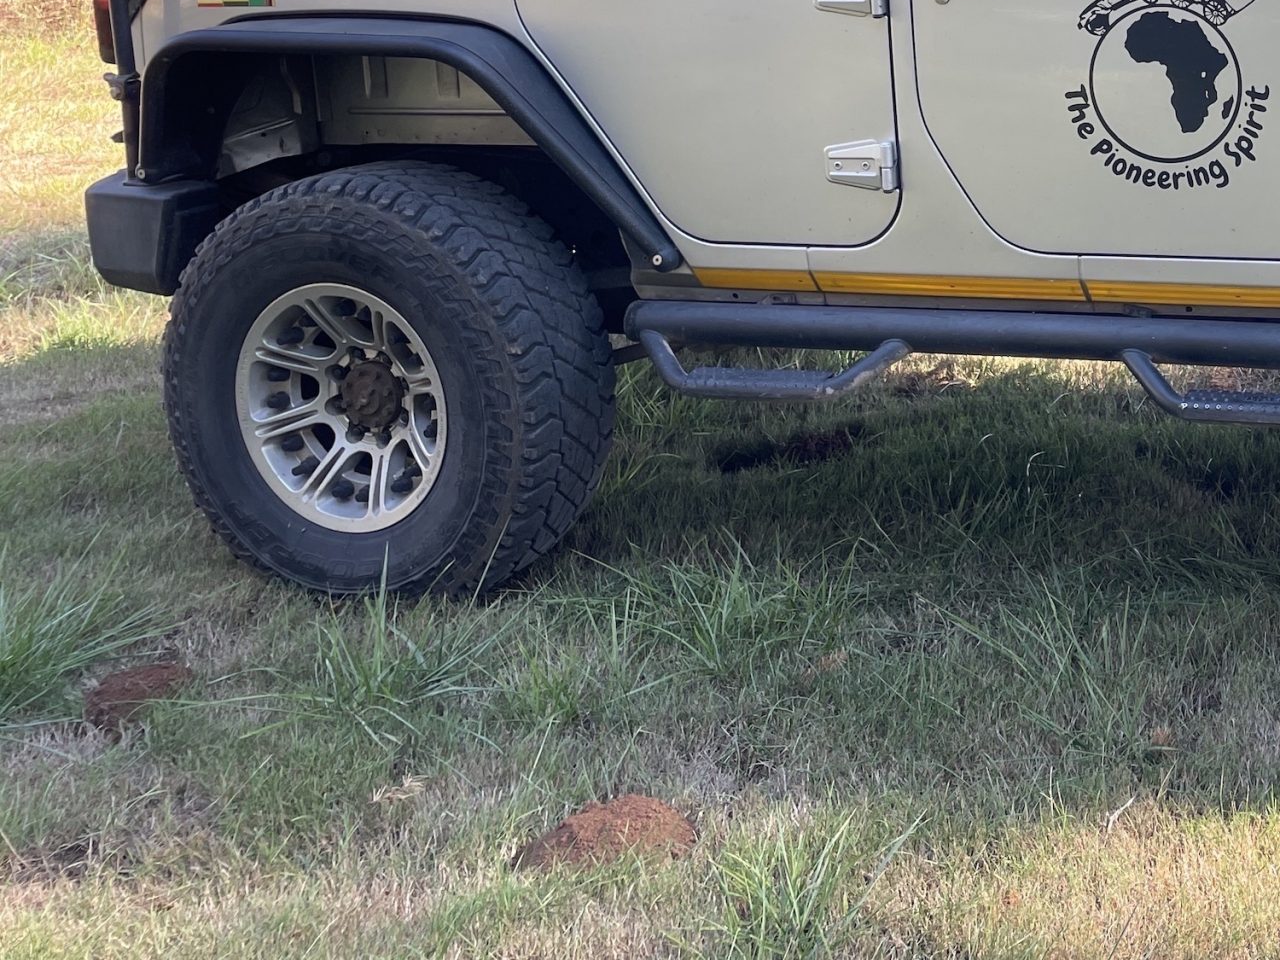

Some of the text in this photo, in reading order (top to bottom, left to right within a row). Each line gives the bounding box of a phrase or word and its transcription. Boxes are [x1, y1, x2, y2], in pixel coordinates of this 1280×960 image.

[1065, 83, 1270, 190] The Pioneering Spirit
